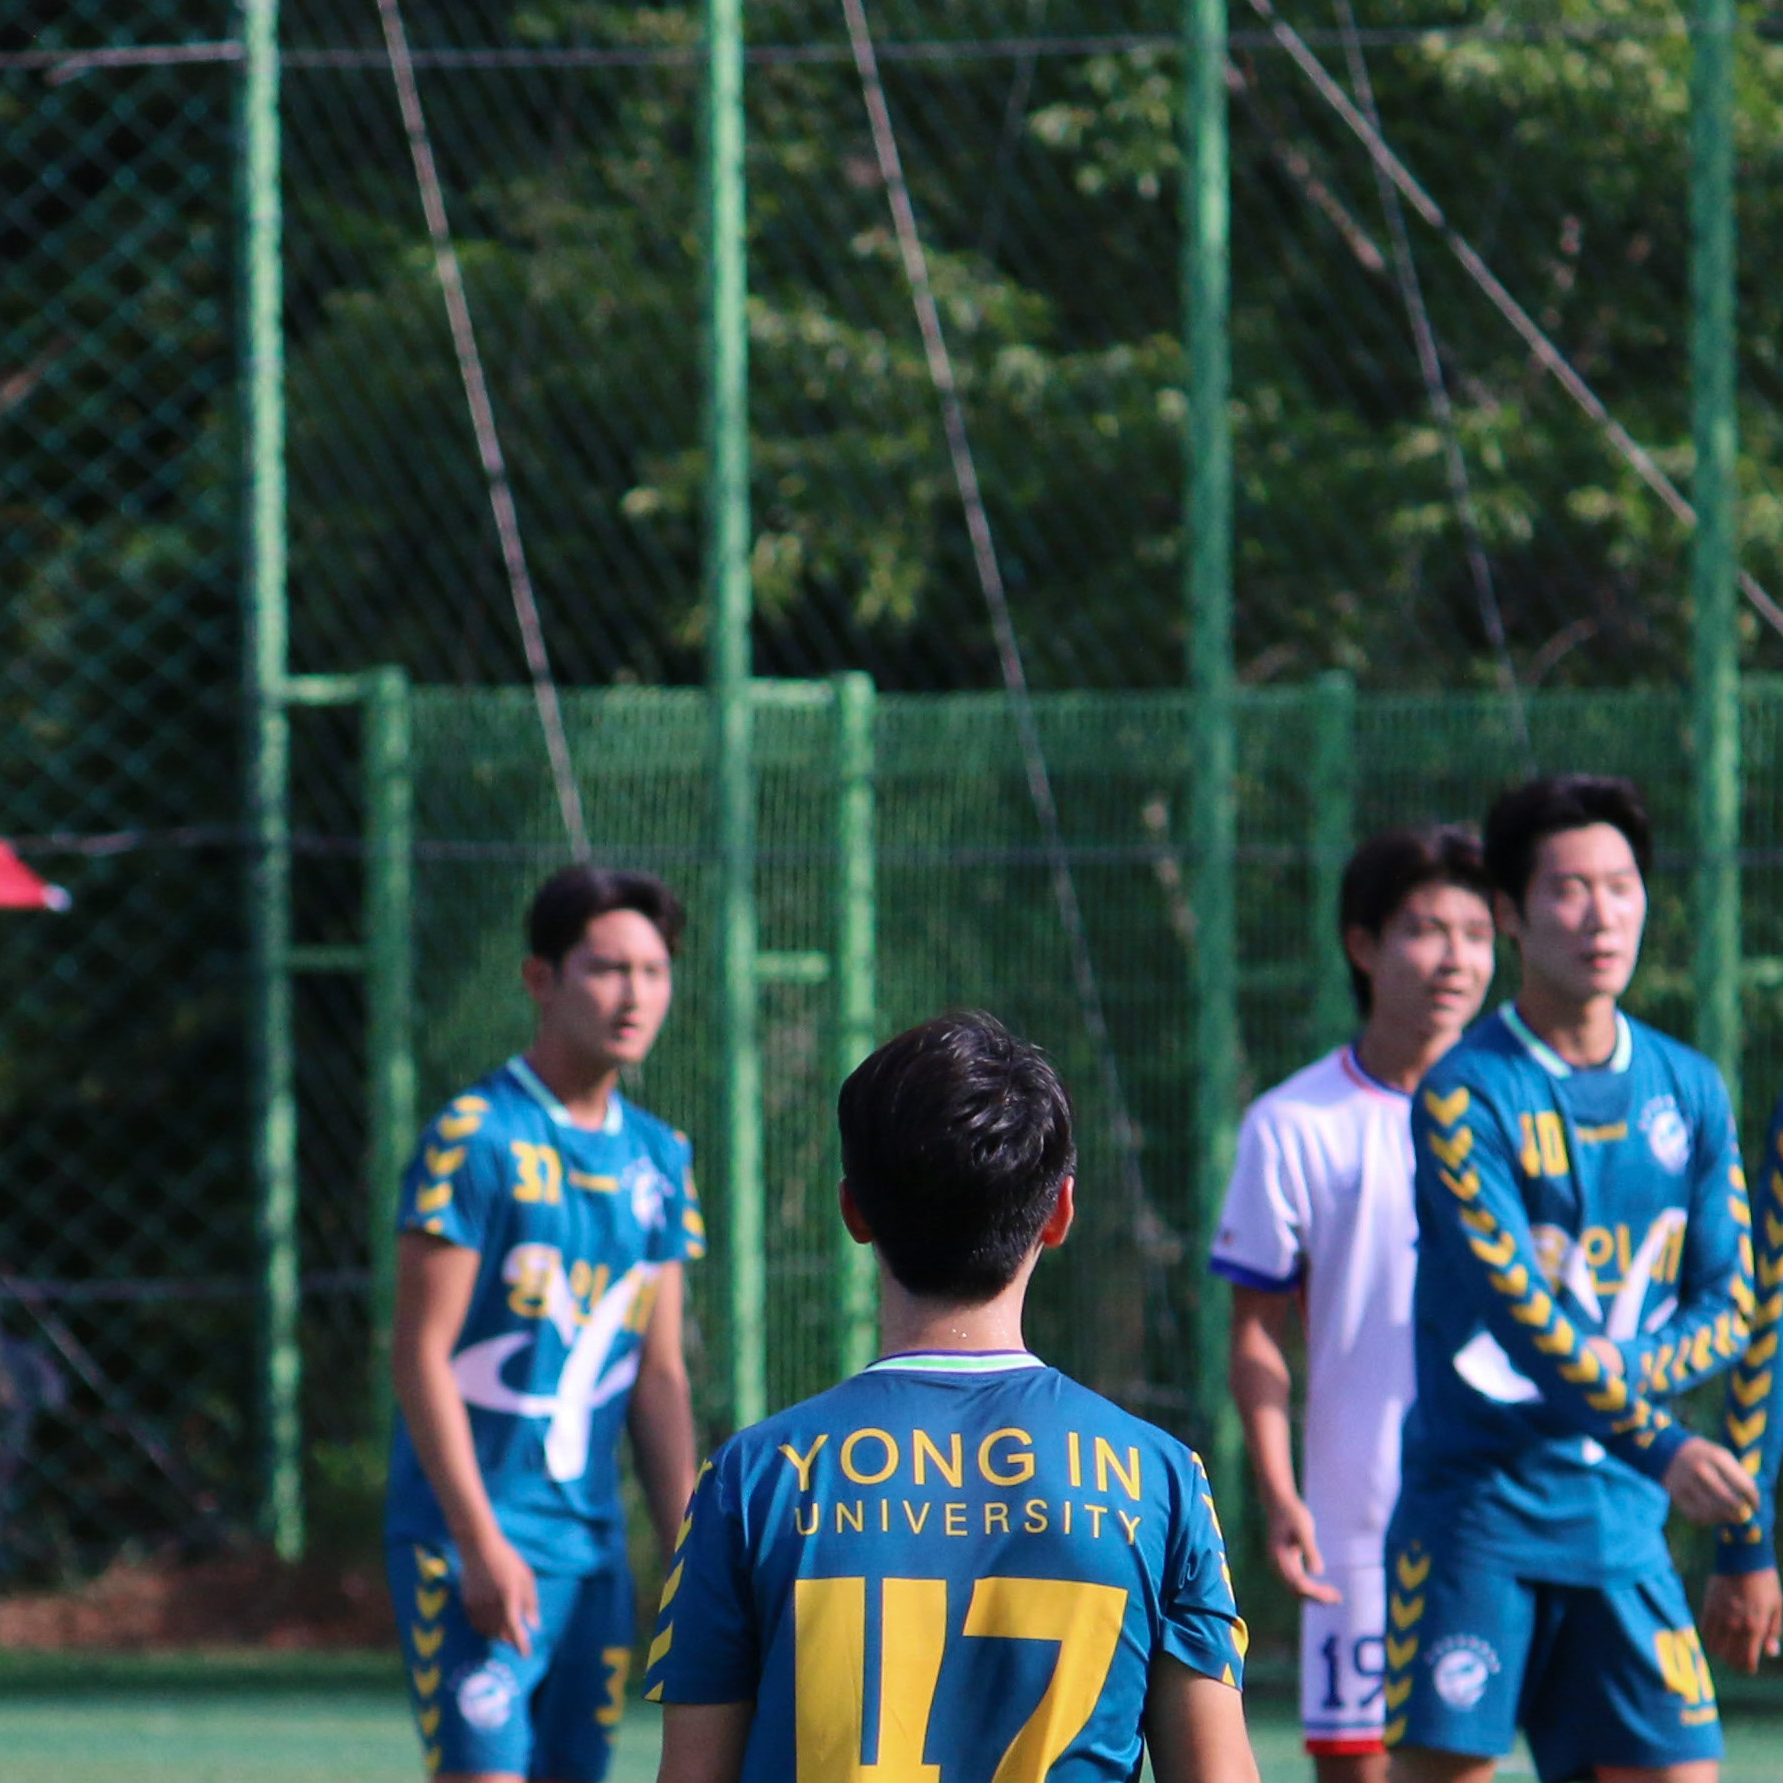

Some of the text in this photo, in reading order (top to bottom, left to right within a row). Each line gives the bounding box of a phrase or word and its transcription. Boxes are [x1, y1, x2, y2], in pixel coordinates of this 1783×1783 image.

[778, 1427, 1141, 1501] YONG IN
[794, 1498, 1141, 1546] UNIVERSITY
[1322, 1634, 1385, 1709] 19
